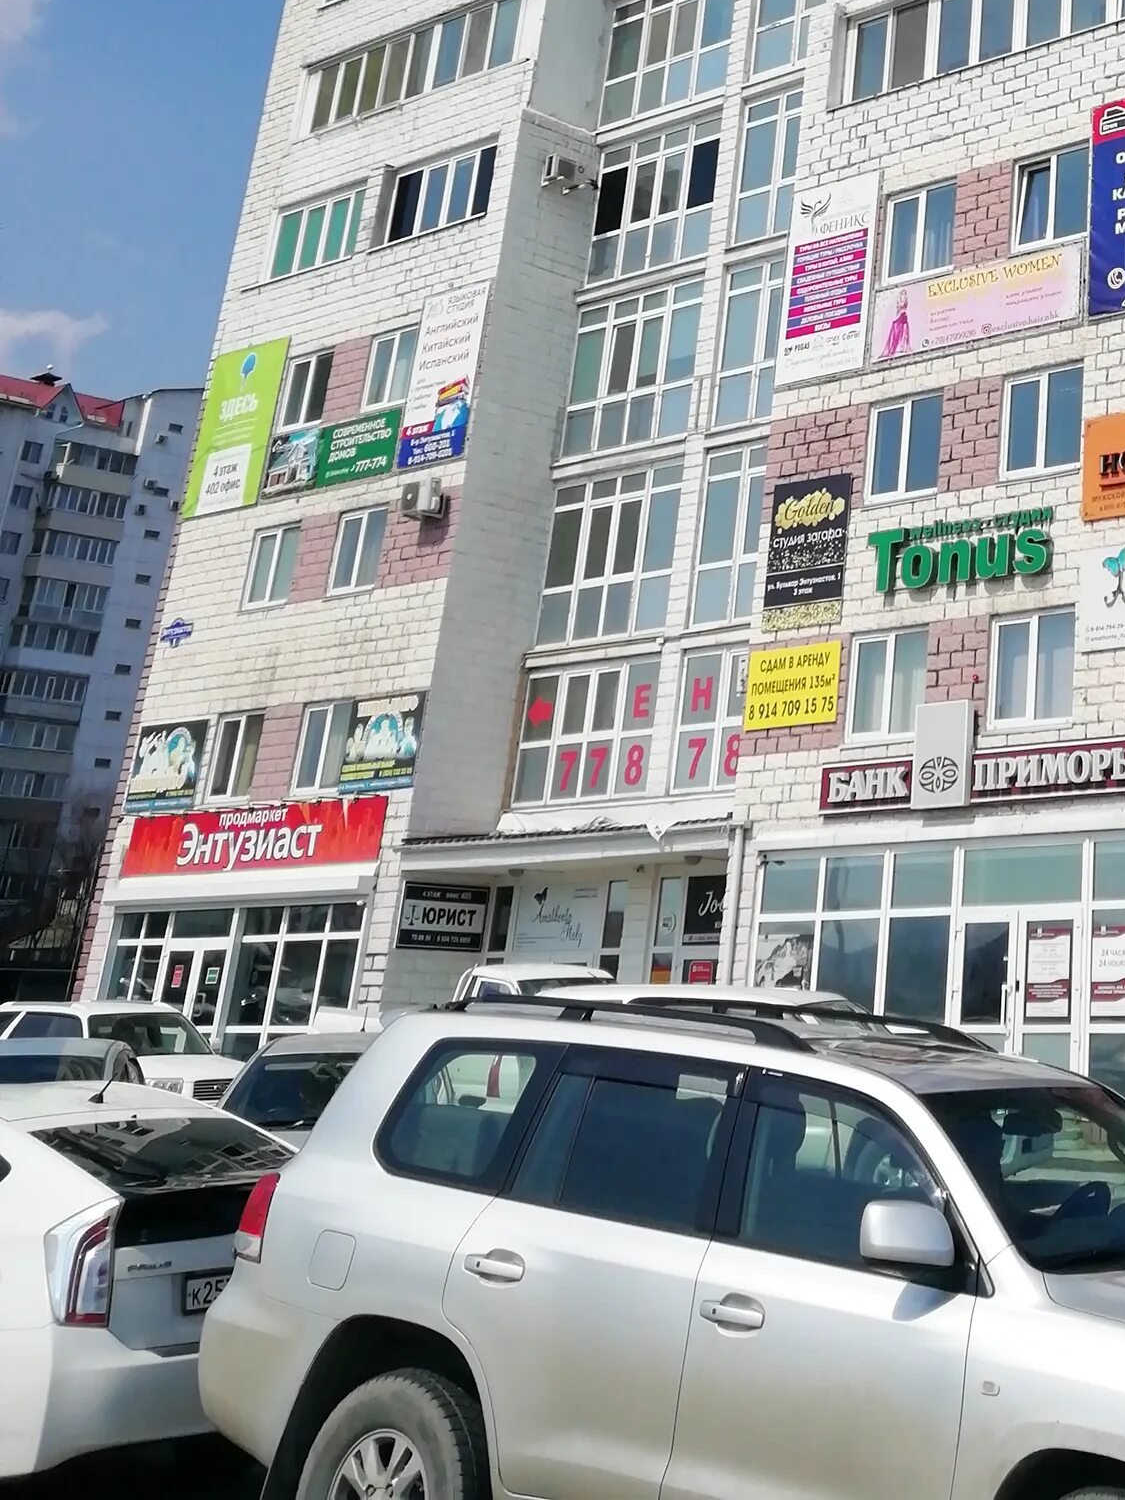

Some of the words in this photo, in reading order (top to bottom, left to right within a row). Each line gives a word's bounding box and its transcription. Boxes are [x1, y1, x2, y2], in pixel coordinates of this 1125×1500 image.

[820, 211, 870, 235] ФЕНИКС
[928, 268, 998, 297] EXCLUSIVE
[1002, 253, 1063, 279] WOMEN
[424, 312, 479, 337] Английский
[421, 331, 471, 354] Китайский
[418, 349, 470, 372] Испанский
[219, 392, 258, 422] ЗДЕСЬ
[330, 428, 392, 451] СТРОИТЕЛЬСТВО
[332, 418, 387, 439] СОВРЕМЕННОЕ
[405, 427, 412, 436] 4
[328, 445, 358, 464] ДОМОВ
[213, 465, 219, 479] 4
[220, 462, 239, 476] этаж
[220, 478, 241, 494] офис
[784, 496, 835, 521] Golden
[867, 527, 1051, 594] Tonus
[760, 657, 786, 674] СДАМ
[788, 656, 794, 669] В
[796, 651, 831, 670] АРЕНДУ
[751, 677, 807, 696] ПОМЕЩЕНИЯ
[748, 704, 755, 721] 8
[758, 702, 777, 719] 914
[781, 699, 801, 717] 709
[804, 697, 817, 714] 15
[821, 695, 834, 713] 75
[827, 766, 909, 803] БАНК
[219, 808, 289, 829] продмаркет
[176, 822, 323, 871] Энтузиаст
[421, 907, 477, 927] ЮРИСТ
[1101, 949, 1109, 957] 24
